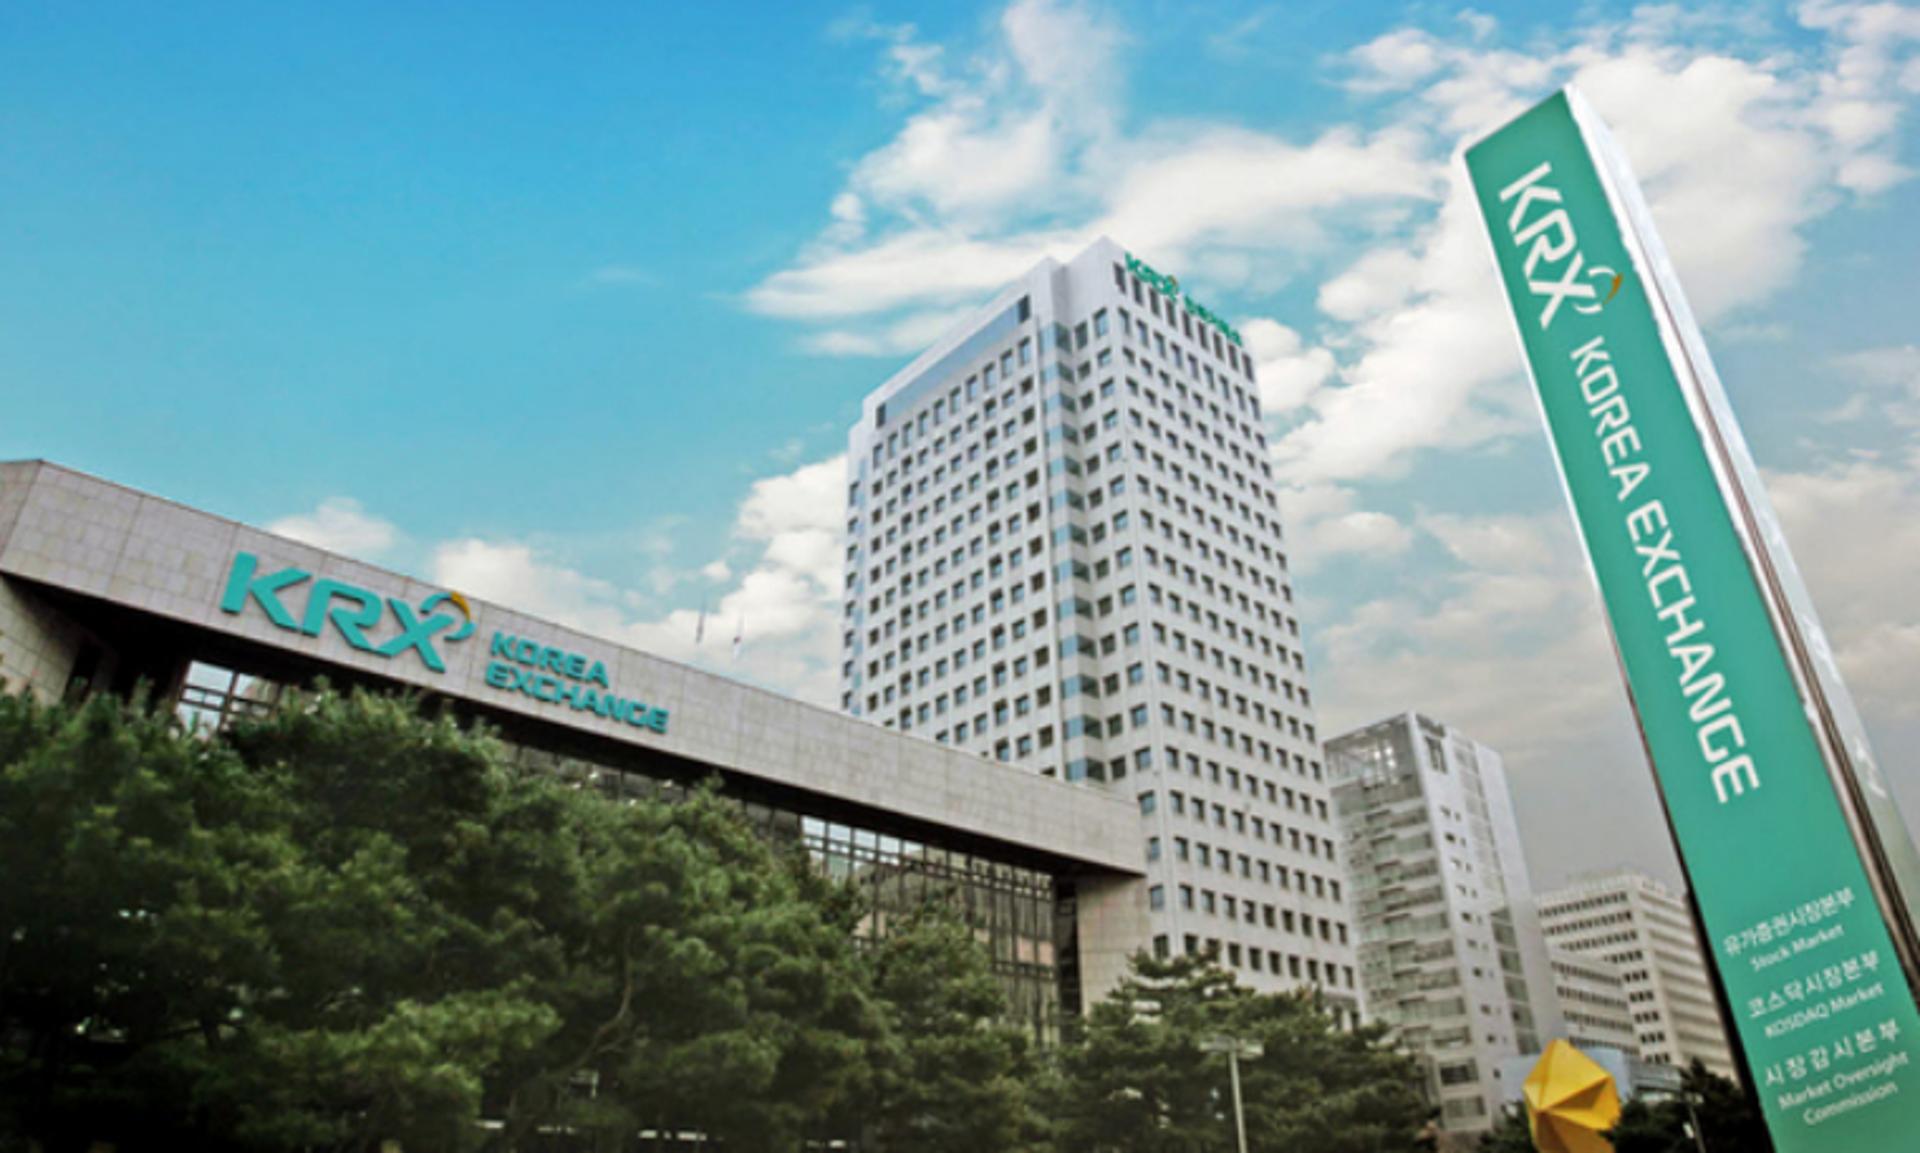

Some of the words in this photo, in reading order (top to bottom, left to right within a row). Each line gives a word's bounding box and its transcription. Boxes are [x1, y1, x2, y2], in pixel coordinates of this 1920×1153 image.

[1499, 161, 1624, 330] KRX
[1570, 336, 1651, 501] KOREA
[1626, 500, 1760, 803] EXCHANGE
[220, 551, 477, 673] KRX
[490, 631, 609, 688] KOREA
[485, 661, 669, 734] EXCHANGE
[1724, 887, 1855, 956] 유가증권시장본부
[1751, 946, 1790, 972] Stock
[1792, 924, 1844, 953] Market
[1749, 950, 1879, 1018] 코스닥시장본부
[1764, 1003, 1829, 1037] KOSDAQ
[1830, 982, 1884, 1012] Market
[1778, 1080, 1832, 1109] Market
[1833, 1051, 1909, 1089] Oversight
[1803, 1082, 1899, 1125] Commission
